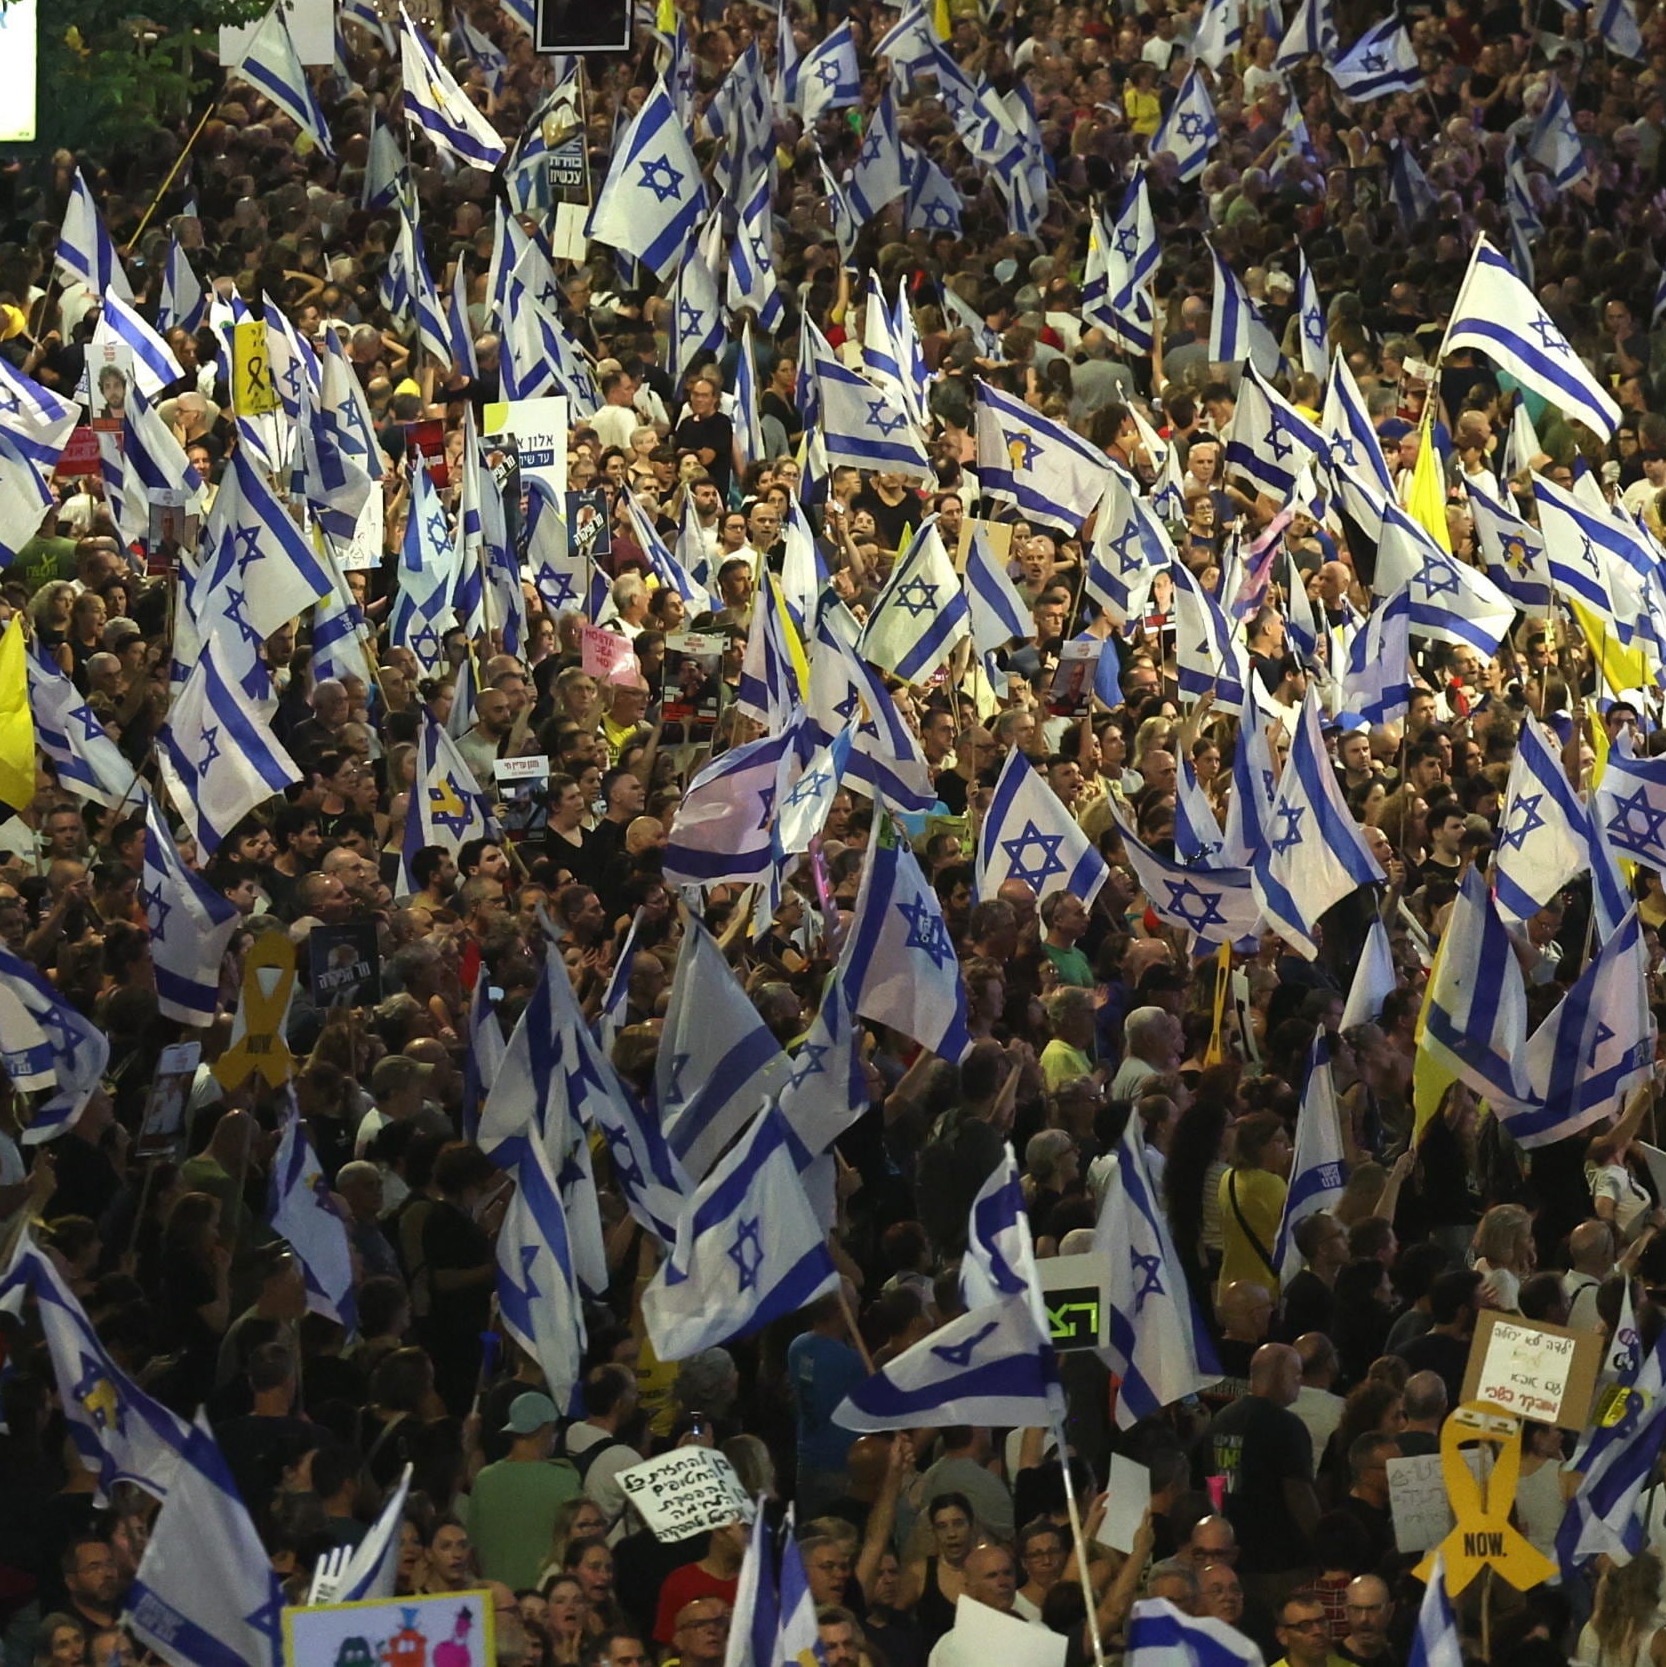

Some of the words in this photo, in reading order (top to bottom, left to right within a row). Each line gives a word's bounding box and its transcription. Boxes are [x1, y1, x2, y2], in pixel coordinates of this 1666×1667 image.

[528, 433, 554, 452] אלון
[585, 626, 615, 647] HOSTA
[594, 646, 613, 658] DEA
[1046, 1302, 1098, 1338] הצ
[1463, 1531, 1508, 1558] NOW.
